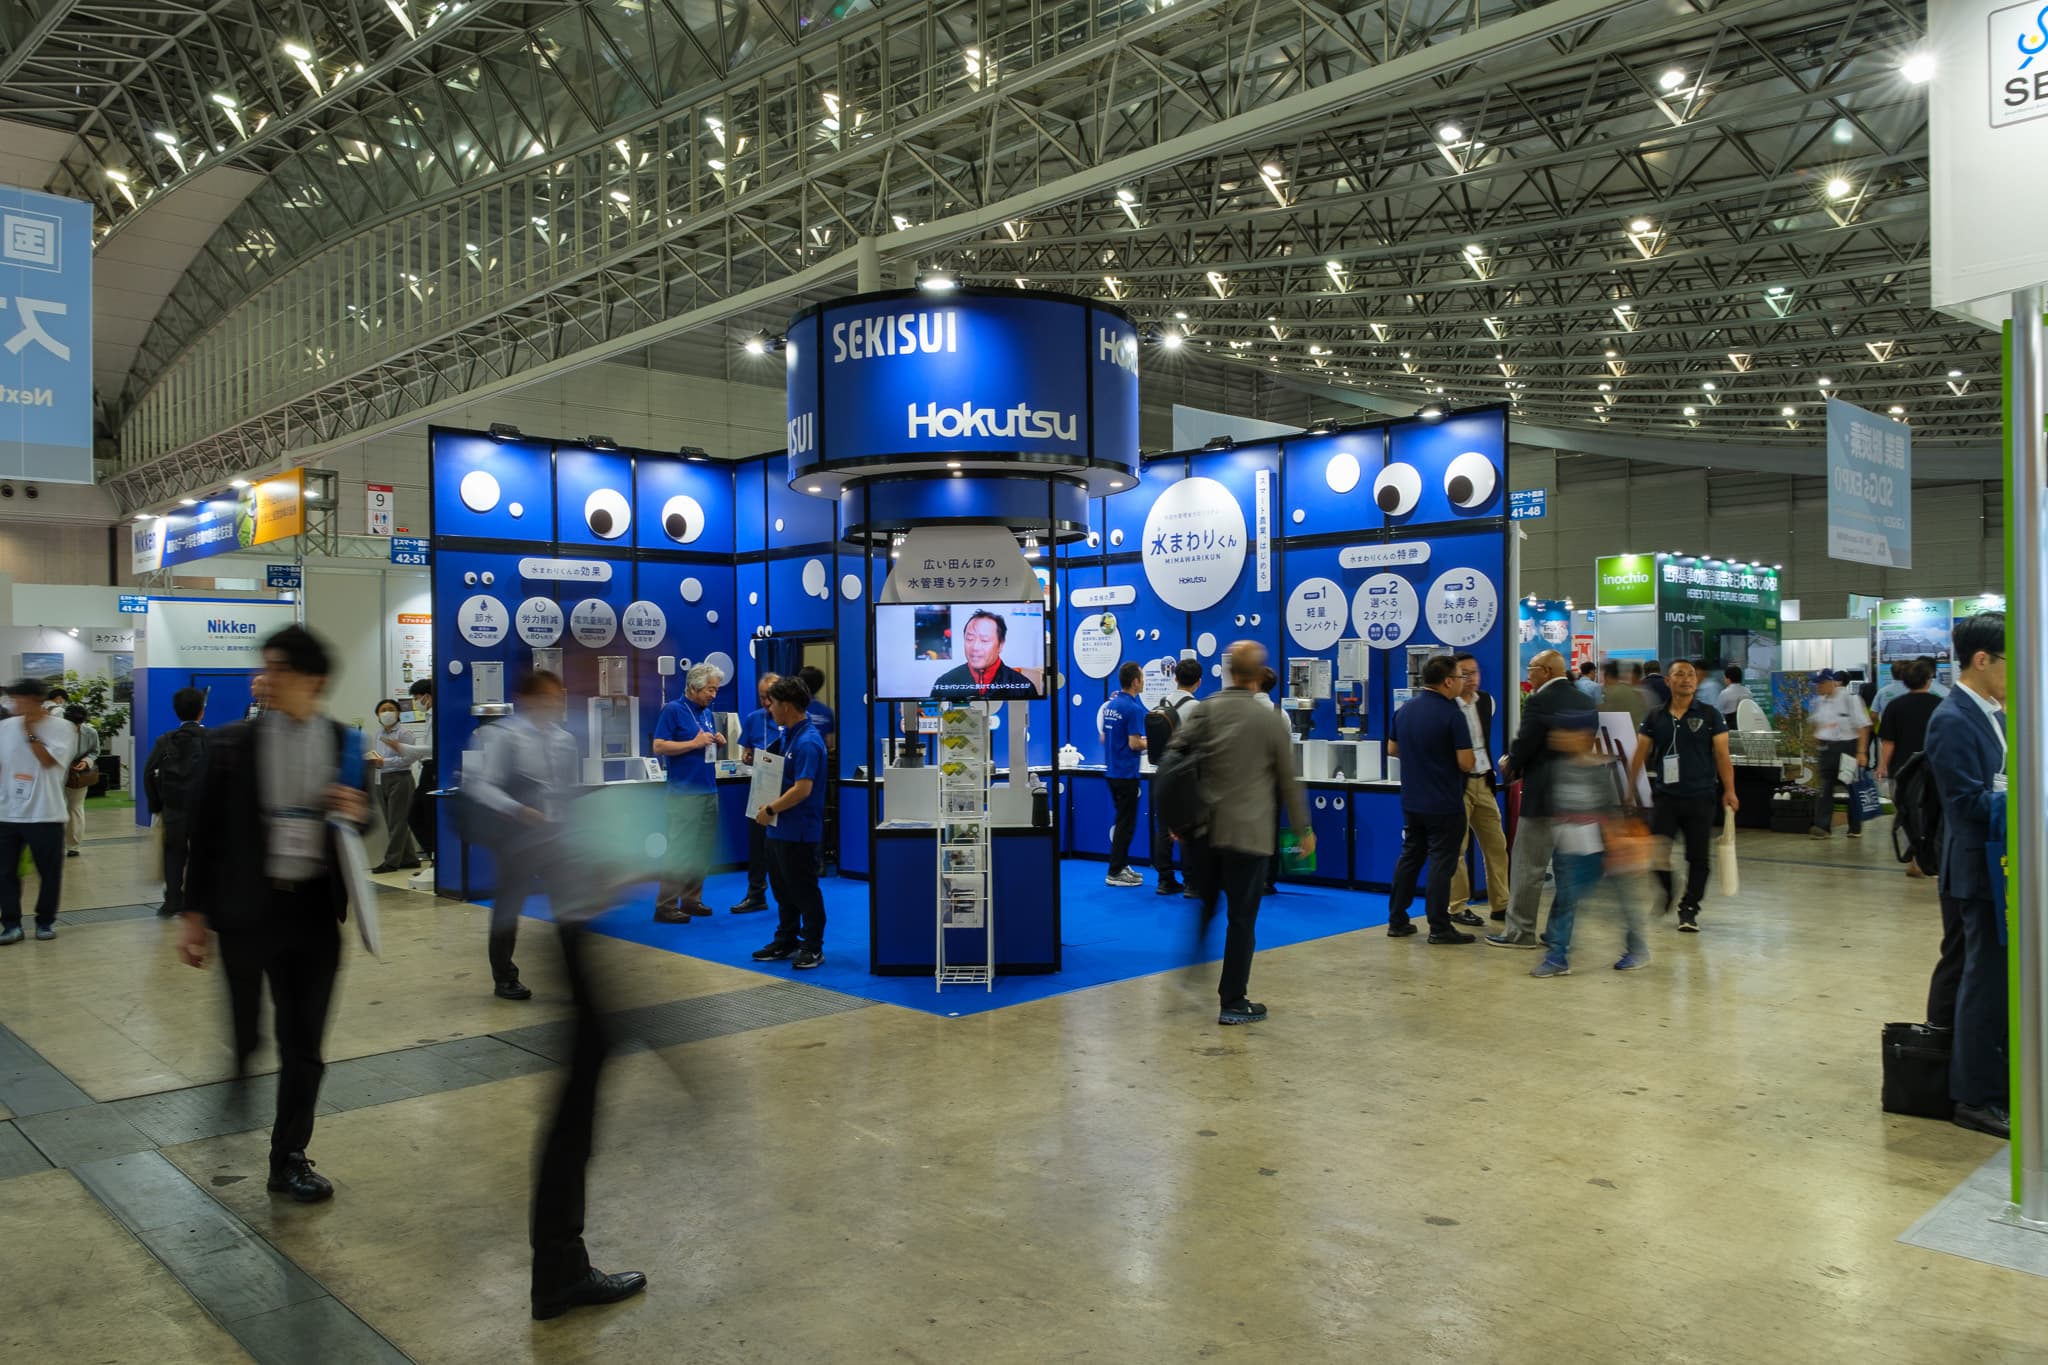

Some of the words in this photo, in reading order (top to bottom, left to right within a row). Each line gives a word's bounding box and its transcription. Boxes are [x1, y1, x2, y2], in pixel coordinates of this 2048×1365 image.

[832, 312, 957, 364] SEKISUI
[908, 400, 1077, 441] Hokutsu
[375, 493, 385, 507] 9
[1512, 505, 1541, 518] 41-48
[1150, 528, 1237, 556] 水まわりくん
[395, 553, 426, 564] 42-51
[1165, 553, 1221, 565] MIMAWARIKUN
[1350, 548, 1419, 563] 水まわりくんの特徴
[923, 558, 996, 570] 広い田んぼの
[531, 566, 601, 577] 水まわりくんの効果
[271, 578, 299, 587] 42-47
[1178, 575, 1207, 584] Hokutsu
[1465, 576, 1475, 590] 3
[1603, 571, 1649, 585] inochio
[1321, 585, 1327, 599] 1
[1389, 581, 1398, 594] 2
[1370, 598, 1398, 608] 選べる
[1444, 597, 1478, 609] 長寿命
[474, 613, 494, 623] 節水
[1307, 607, 1327, 617] 軽量
[1449, 612, 1481, 624] 10年!
[522, 615, 559, 625] 労力削減
[627, 616, 661, 627] 収量増加
[1295, 620, 1338, 631] コンパクト
[207, 619, 256, 634] Nikken
